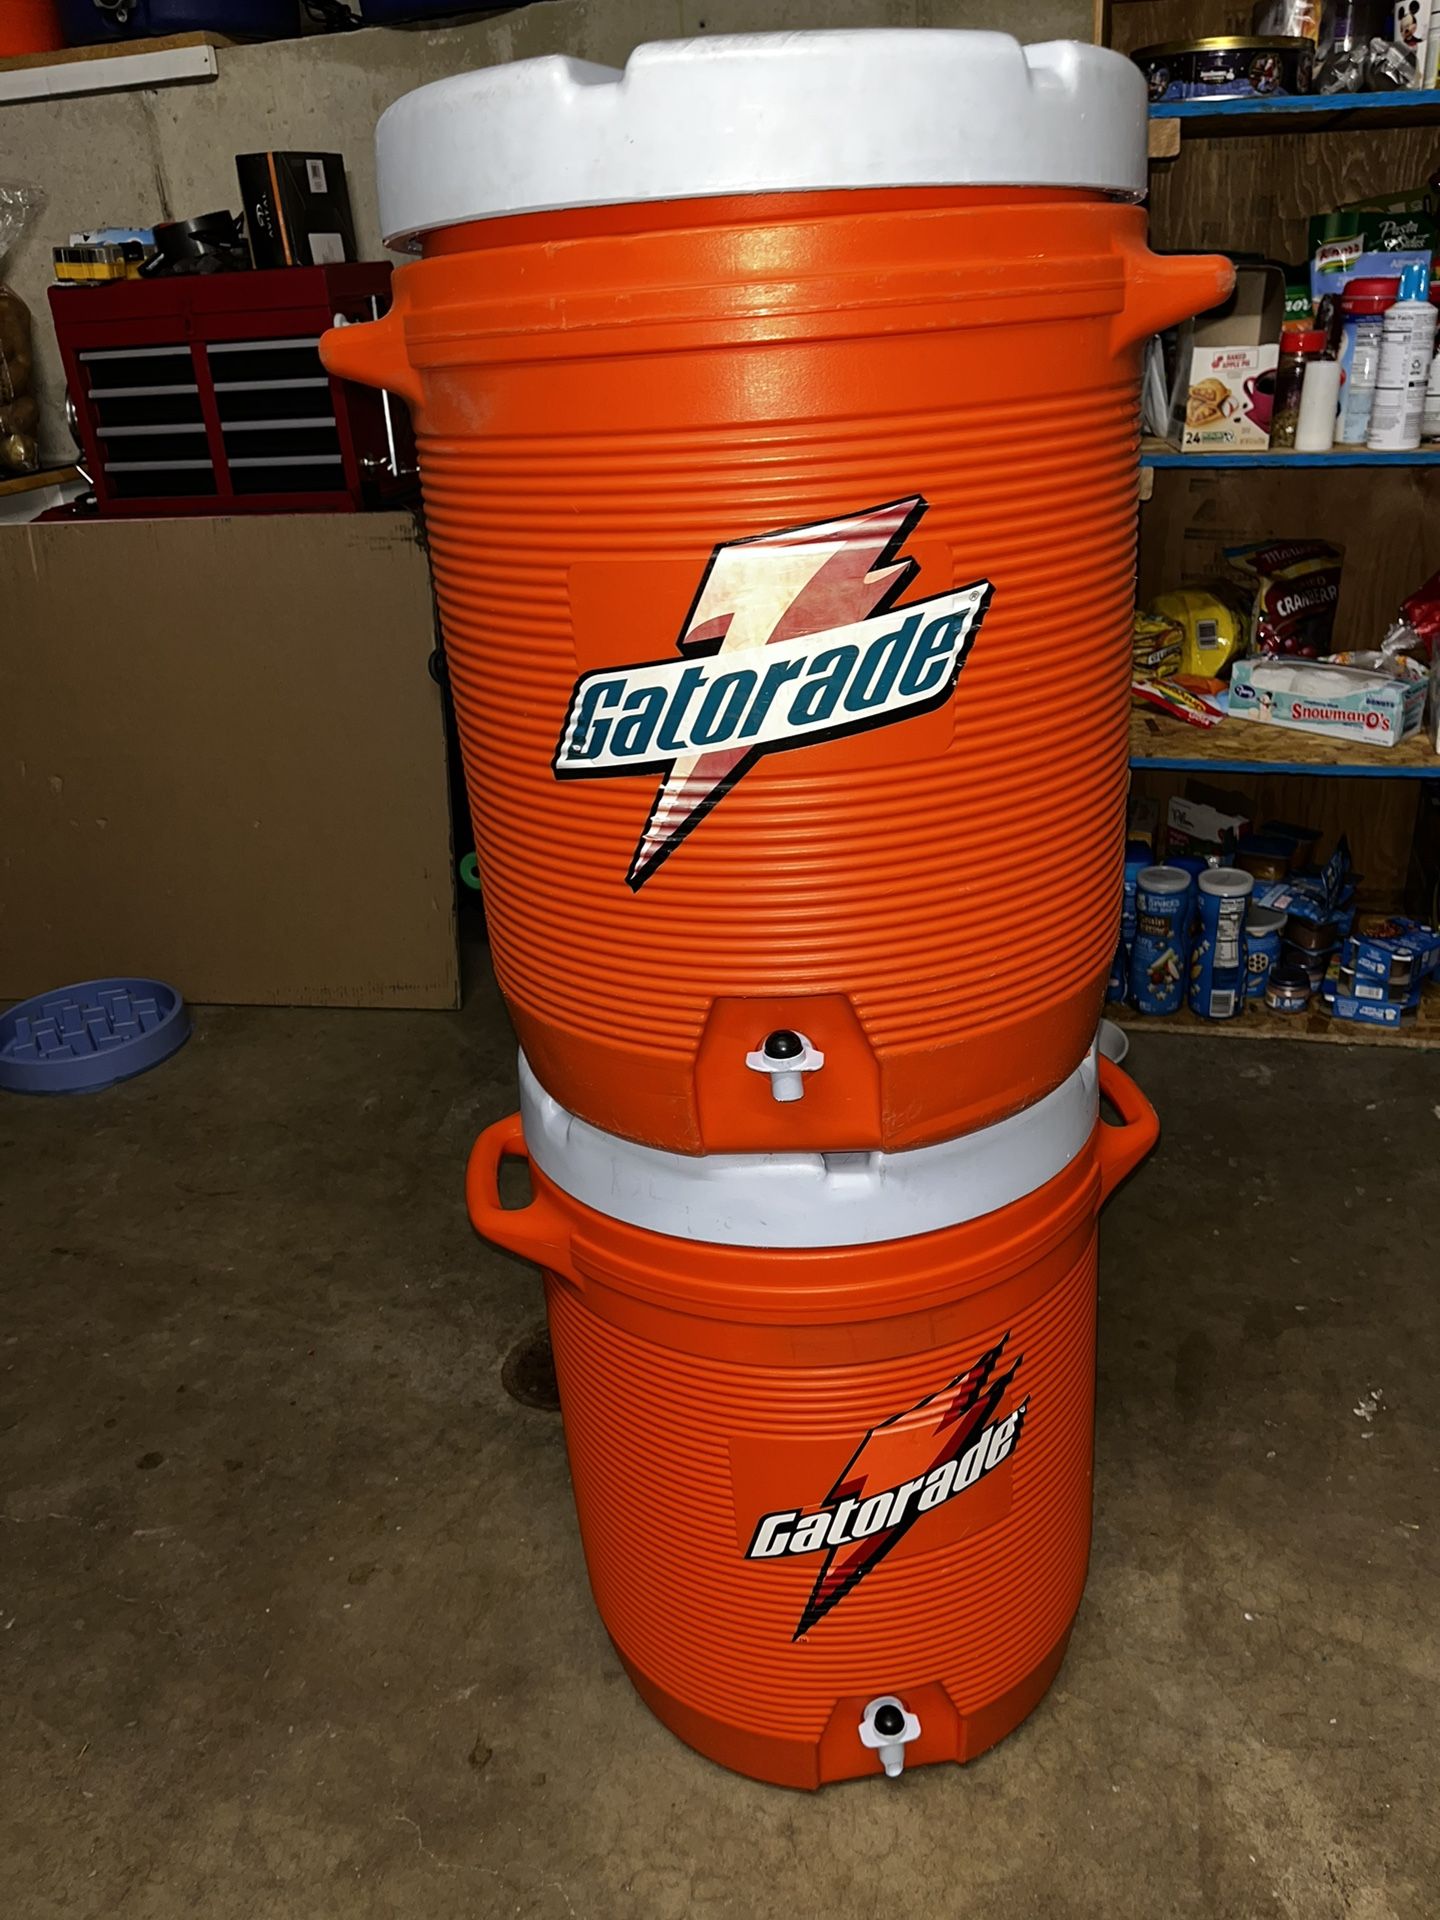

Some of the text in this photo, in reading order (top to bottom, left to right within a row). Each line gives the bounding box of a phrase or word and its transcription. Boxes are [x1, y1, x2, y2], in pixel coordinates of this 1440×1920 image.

[1379, 220, 1419, 238] Pasta
[1186, 431, 1201, 444] 24
[566, 605, 972, 762] Gatorade
[1292, 703, 1391, 731] SnowmanO's
[750, 1414, 1017, 1558] Gatorade
